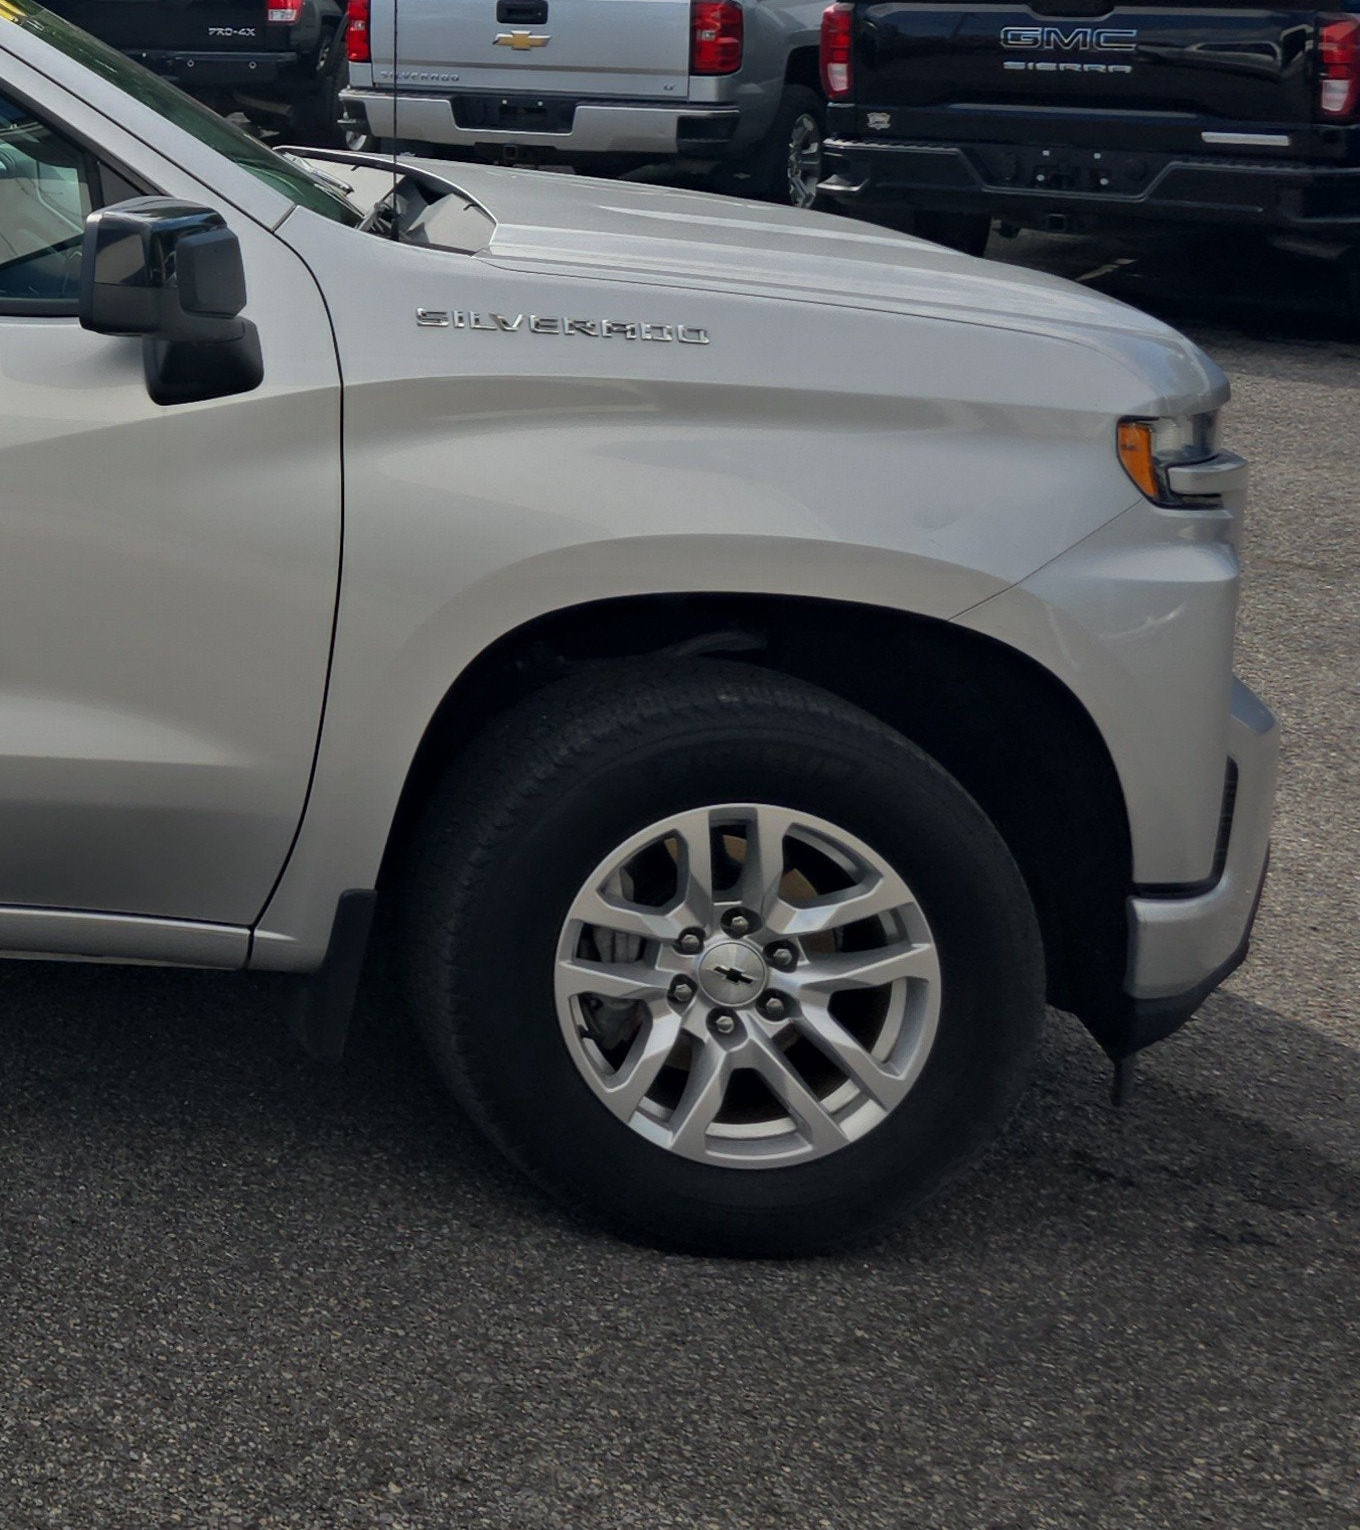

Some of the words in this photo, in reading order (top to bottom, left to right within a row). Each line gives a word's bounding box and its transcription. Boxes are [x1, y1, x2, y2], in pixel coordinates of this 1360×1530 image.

[208, 27, 257, 37] PRO-4X
[1000, 26, 1138, 52] GMC
[1003, 61, 1133, 74] SIERRA
[415, 306, 710, 345] SILVERADO
